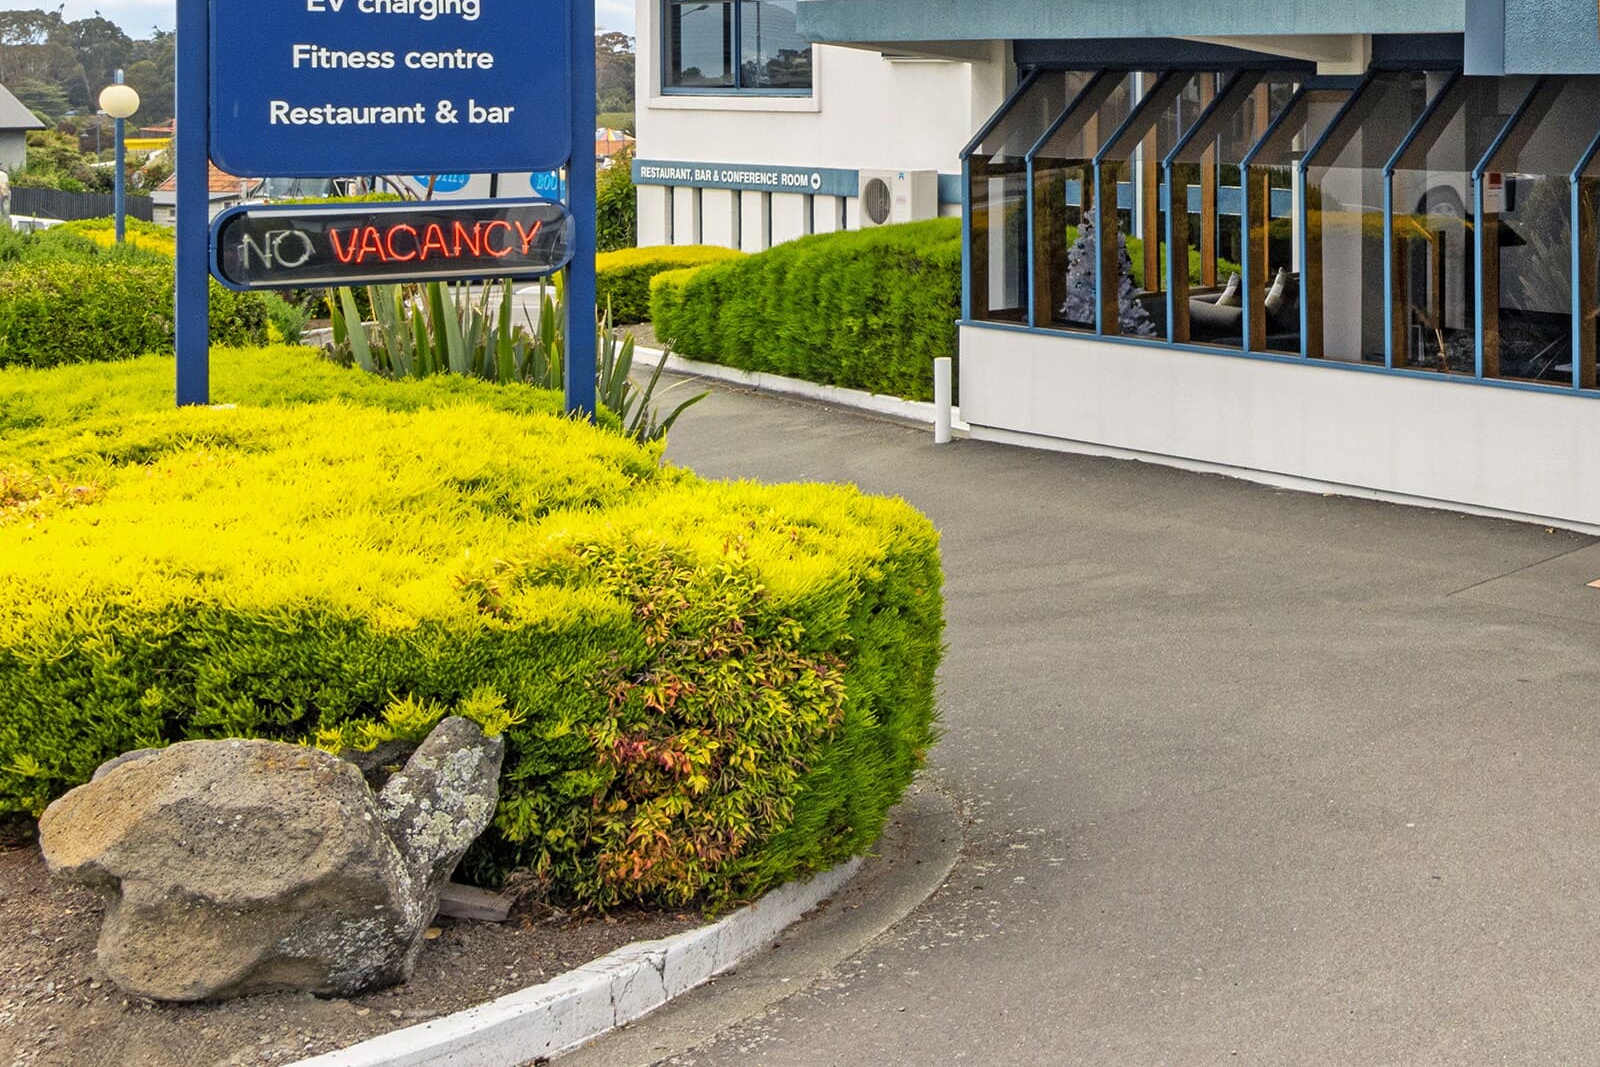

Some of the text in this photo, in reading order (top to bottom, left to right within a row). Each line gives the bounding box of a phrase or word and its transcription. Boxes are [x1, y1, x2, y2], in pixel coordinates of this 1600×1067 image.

[293, 45, 494, 70] Fitness centre
[270, 99, 515, 126] Restaurant & bar
[640, 166, 809, 186] RESTAURANT, BAR & CONFERENCE ROOM
[242, 220, 542, 270] NO VACANCY
